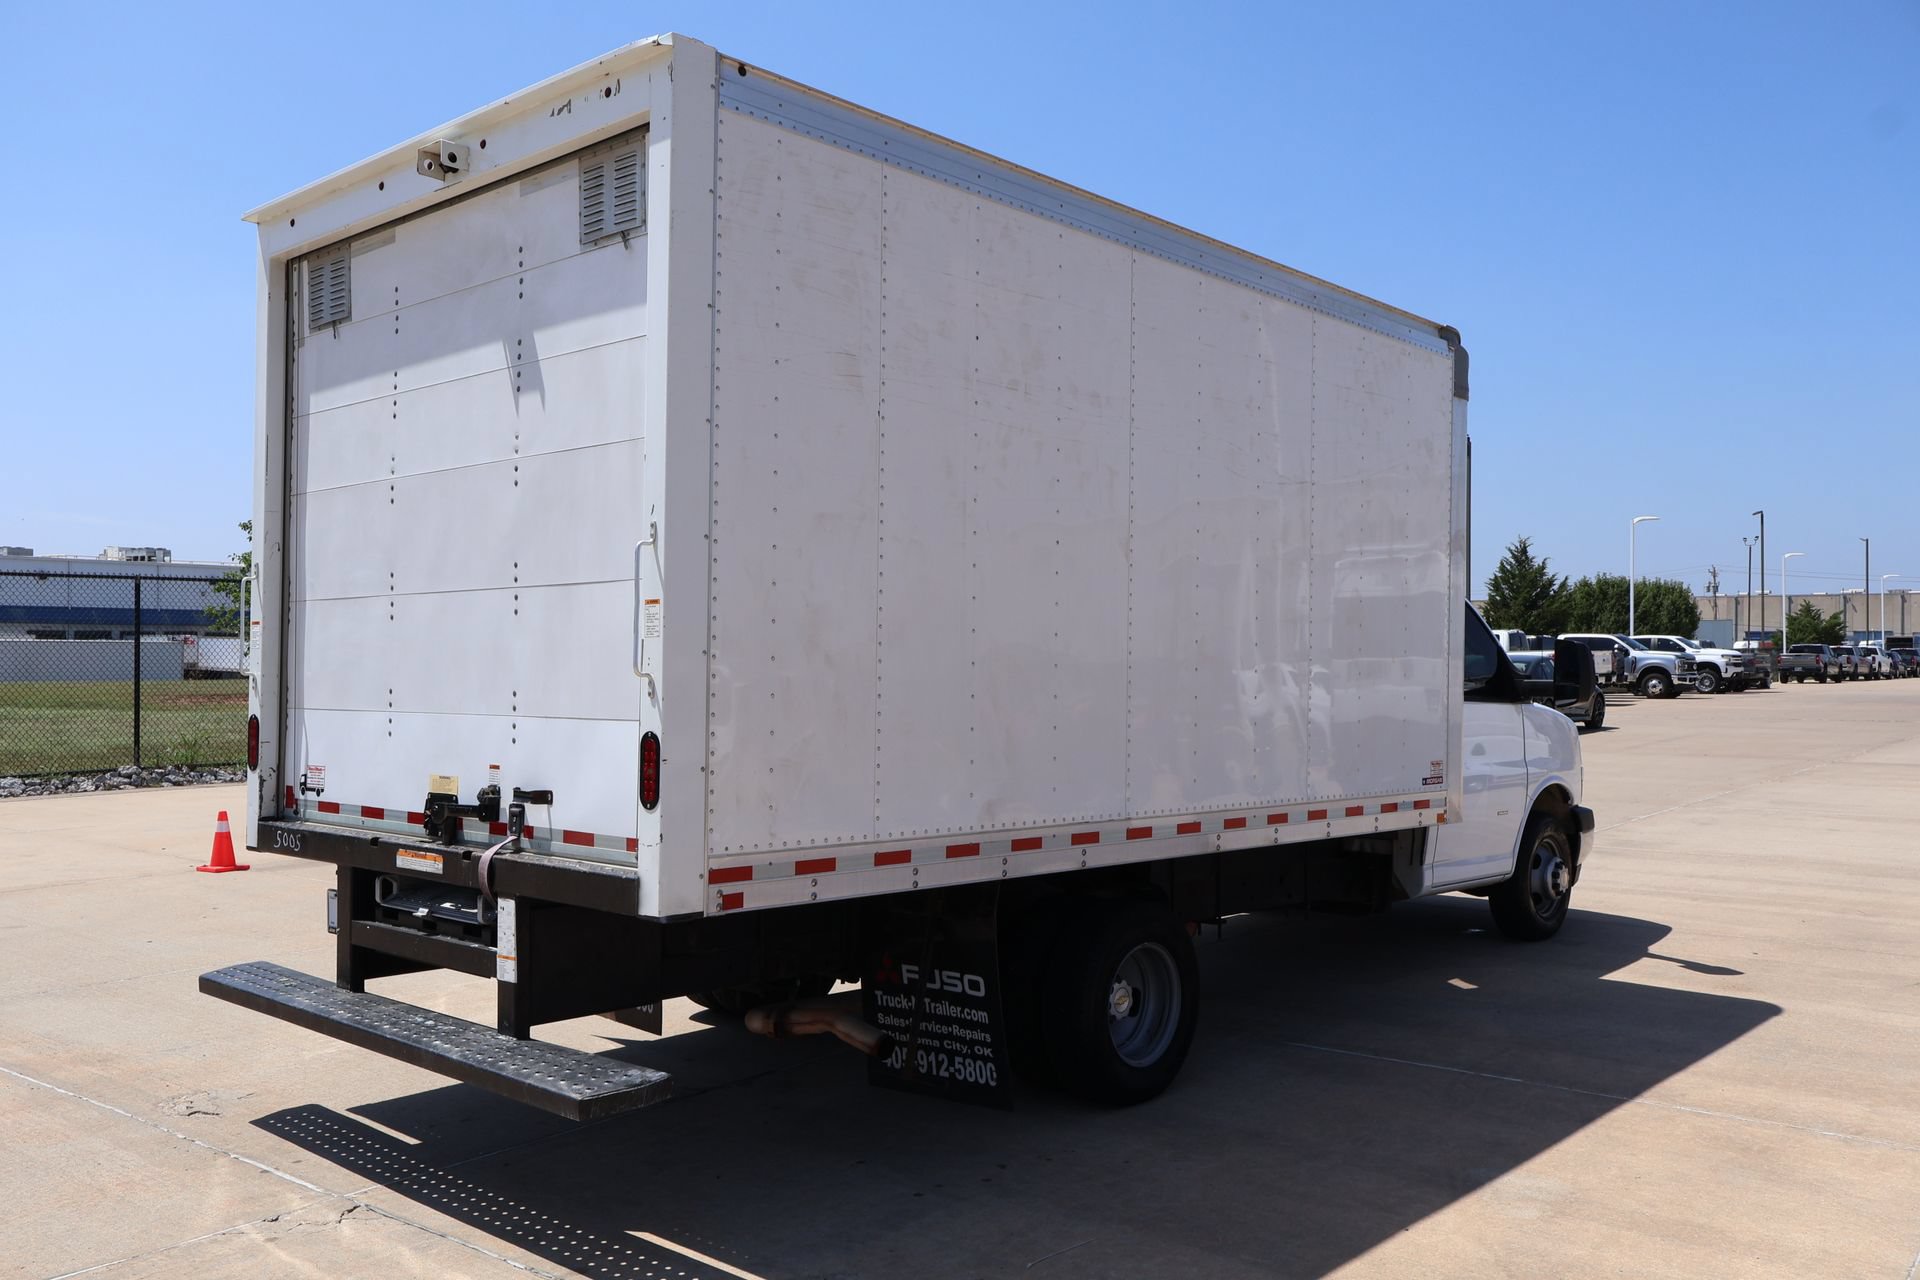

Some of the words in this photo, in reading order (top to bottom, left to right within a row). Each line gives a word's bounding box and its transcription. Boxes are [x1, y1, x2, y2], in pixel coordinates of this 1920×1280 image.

[273, 830, 301, 852] 5005
[943, 1040, 971, 1054] City,
[974, 1045, 994, 1058] OK
